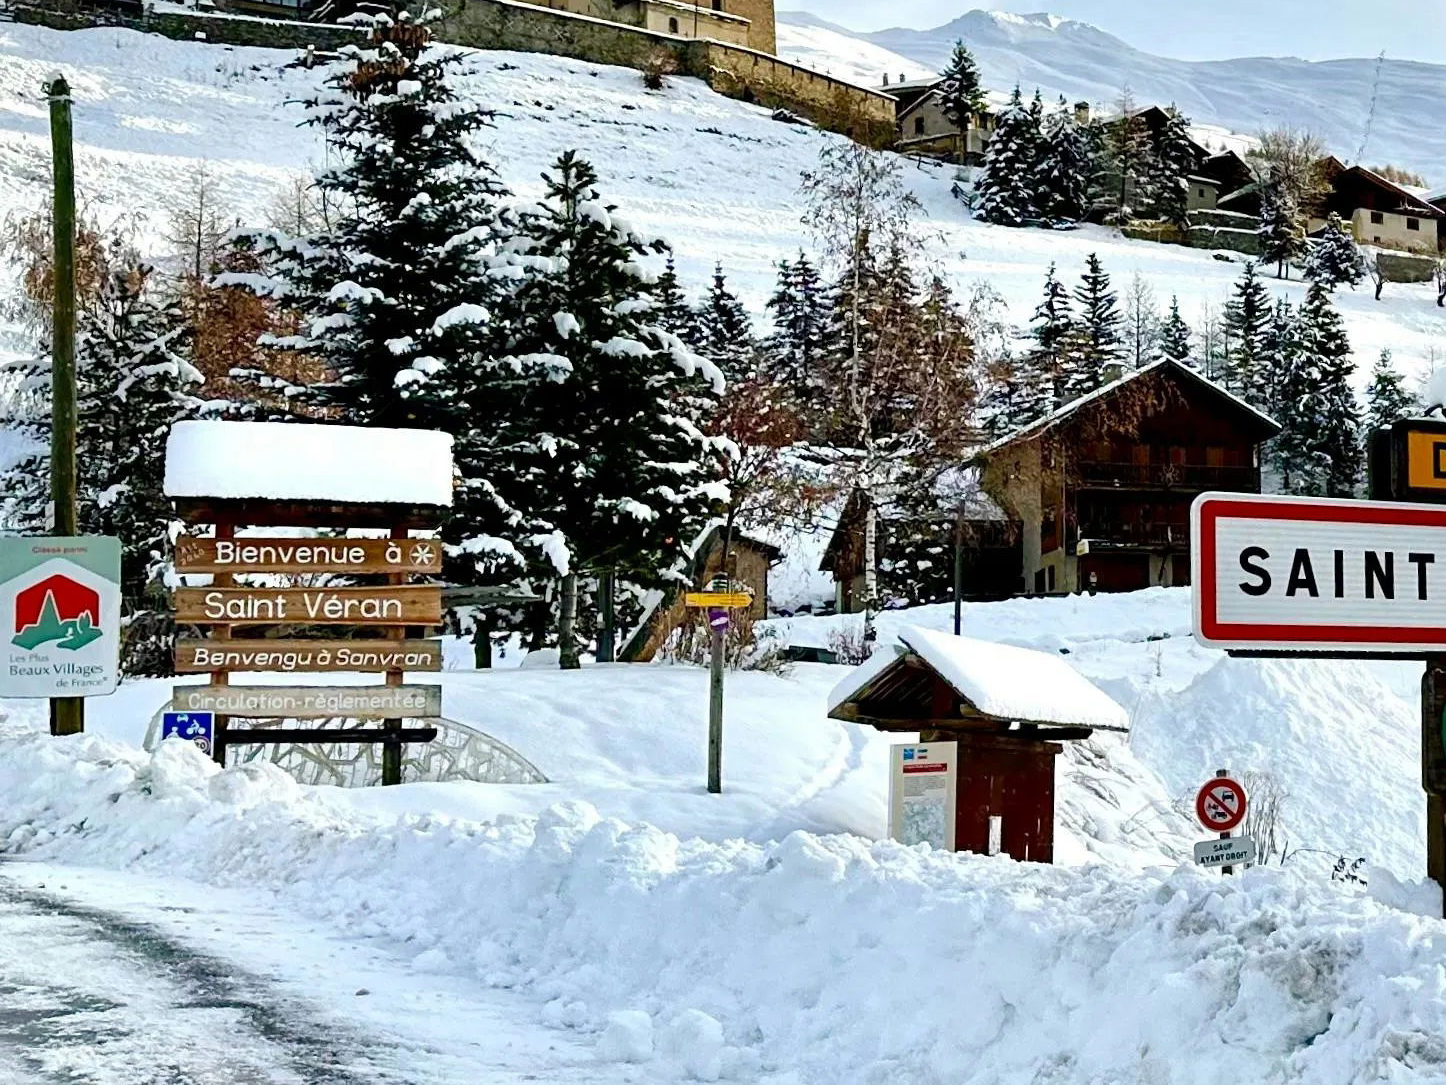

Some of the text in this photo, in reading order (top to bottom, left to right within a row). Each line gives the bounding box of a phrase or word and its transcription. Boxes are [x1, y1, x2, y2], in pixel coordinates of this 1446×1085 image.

[214, 541, 402, 565] Bienvenue à
[204, 592, 402, 619] Saint Véran
[9, 653, 50, 663] Les Plus
[193, 648, 432, 670] Benvengu à Sanvran
[9, 663, 105, 677] Beaux Villages
[55, 679, 69, 687] de
[1213, 843, 1233, 852] SAUF
[1200, 850, 1248, 864] AYANT DROIT
